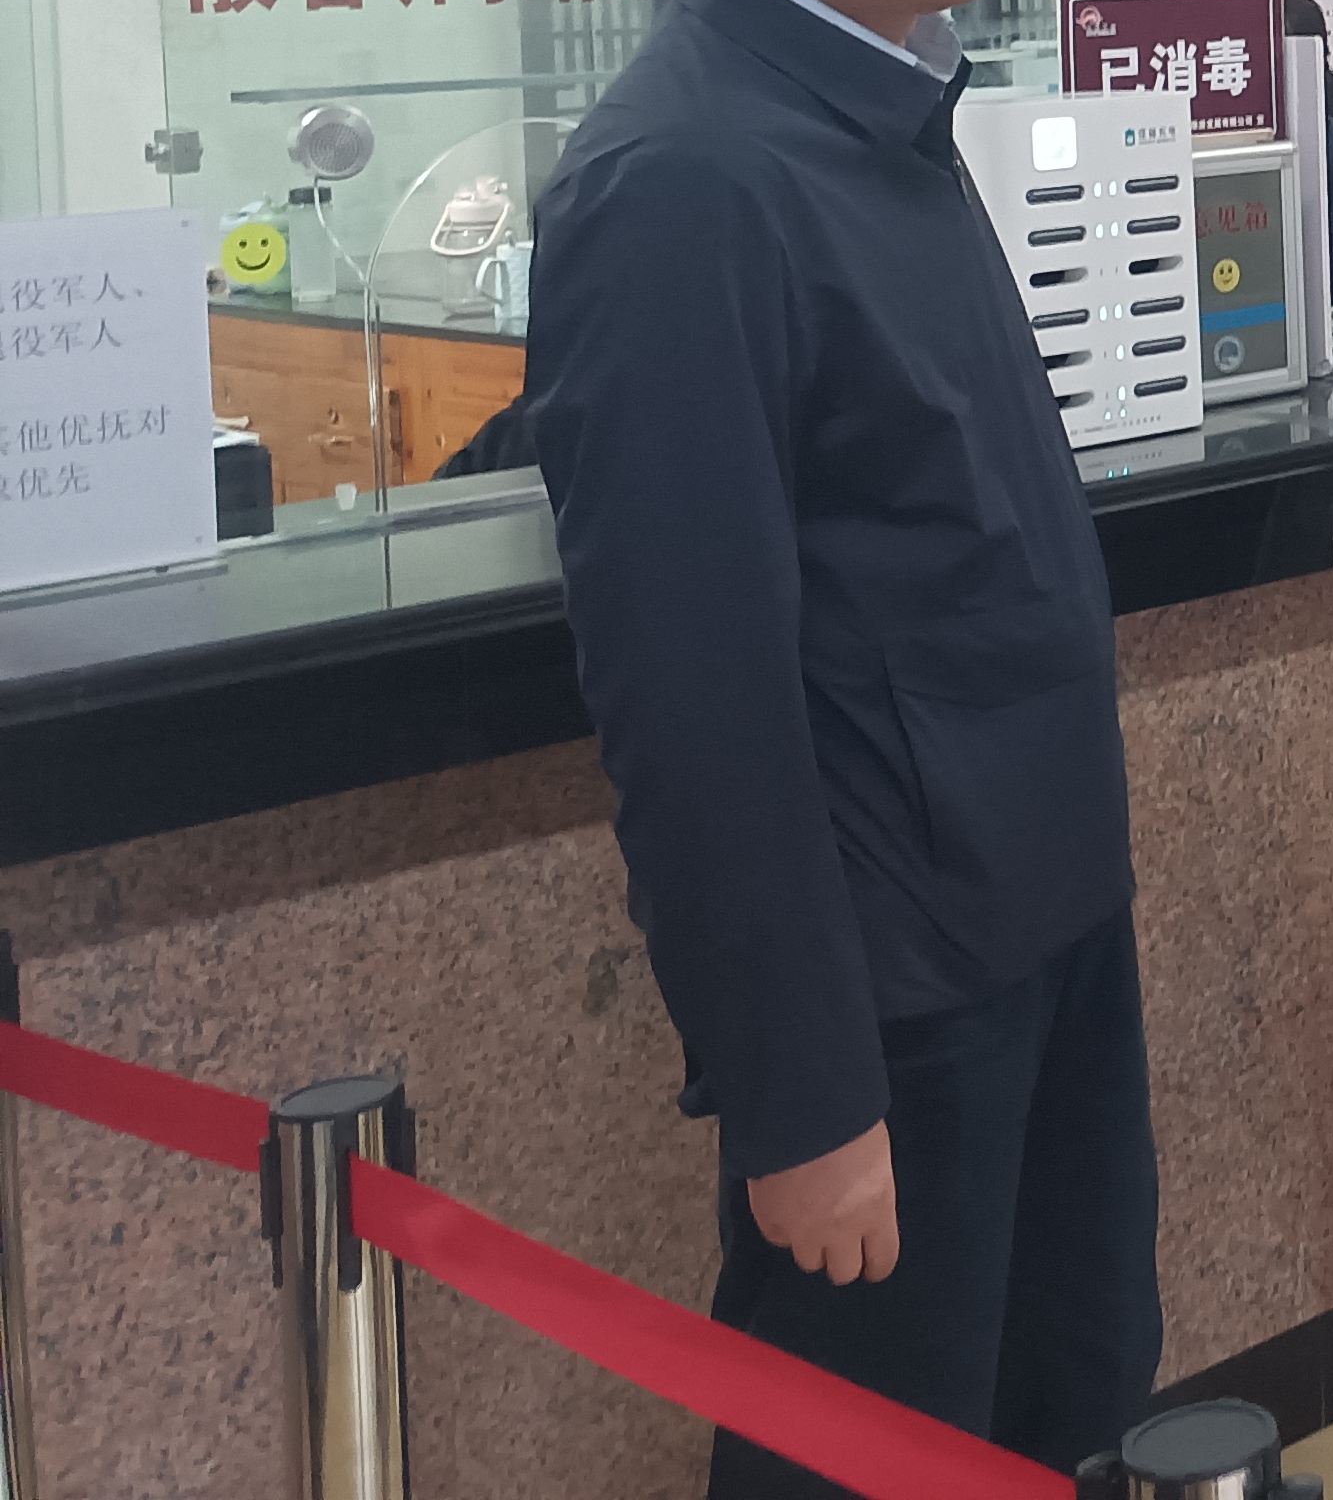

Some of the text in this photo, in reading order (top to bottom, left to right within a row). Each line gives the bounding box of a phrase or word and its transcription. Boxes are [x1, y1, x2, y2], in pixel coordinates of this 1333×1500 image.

[1100, 36, 1252, 98] 已消毒
[0, 272, 143, 314] 役军人、
[0, 317, 122, 361] 役军人
[0, 403, 171, 456] 他优抚对
[0, 461, 91, 501] 优先
